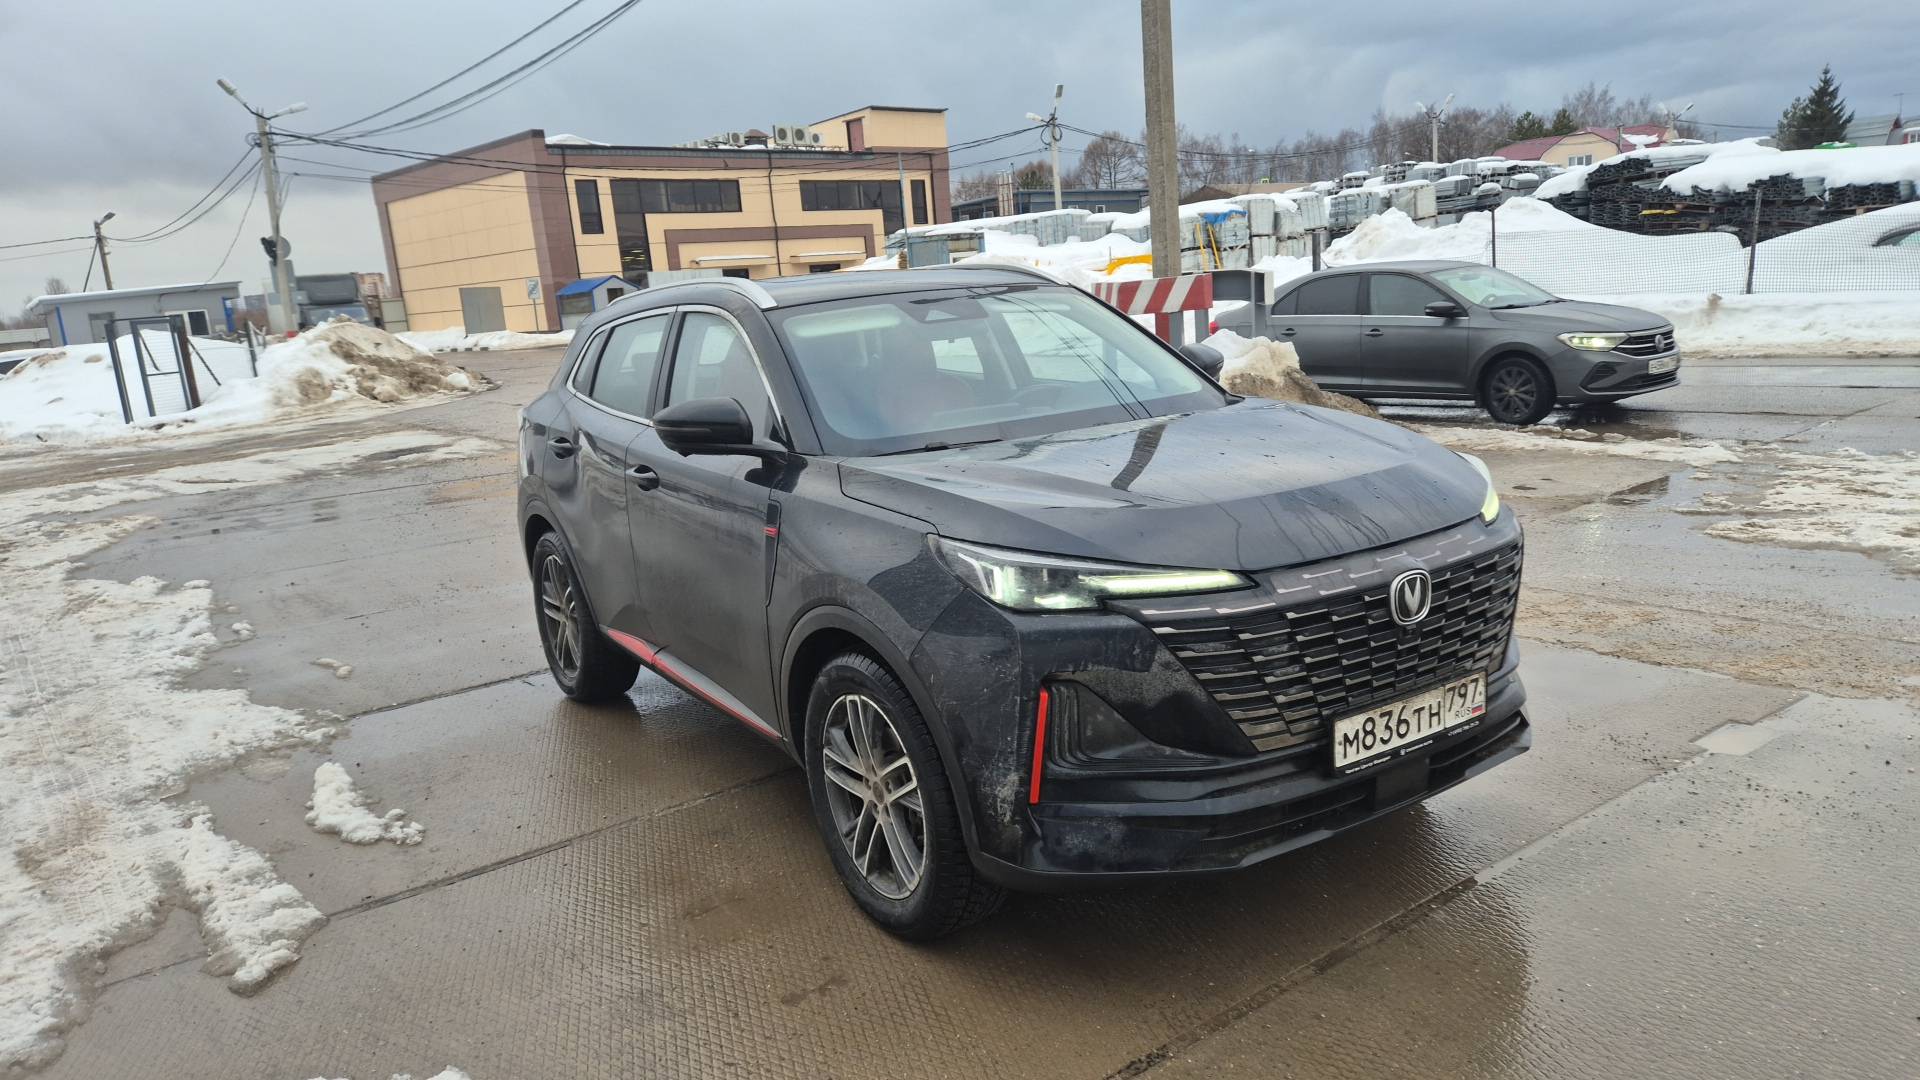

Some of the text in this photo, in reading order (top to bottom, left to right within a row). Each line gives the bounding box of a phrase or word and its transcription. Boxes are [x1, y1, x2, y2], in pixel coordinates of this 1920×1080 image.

[1343, 677, 1479, 759] М836ТН 797
[1455, 706, 1472, 719] RUS
